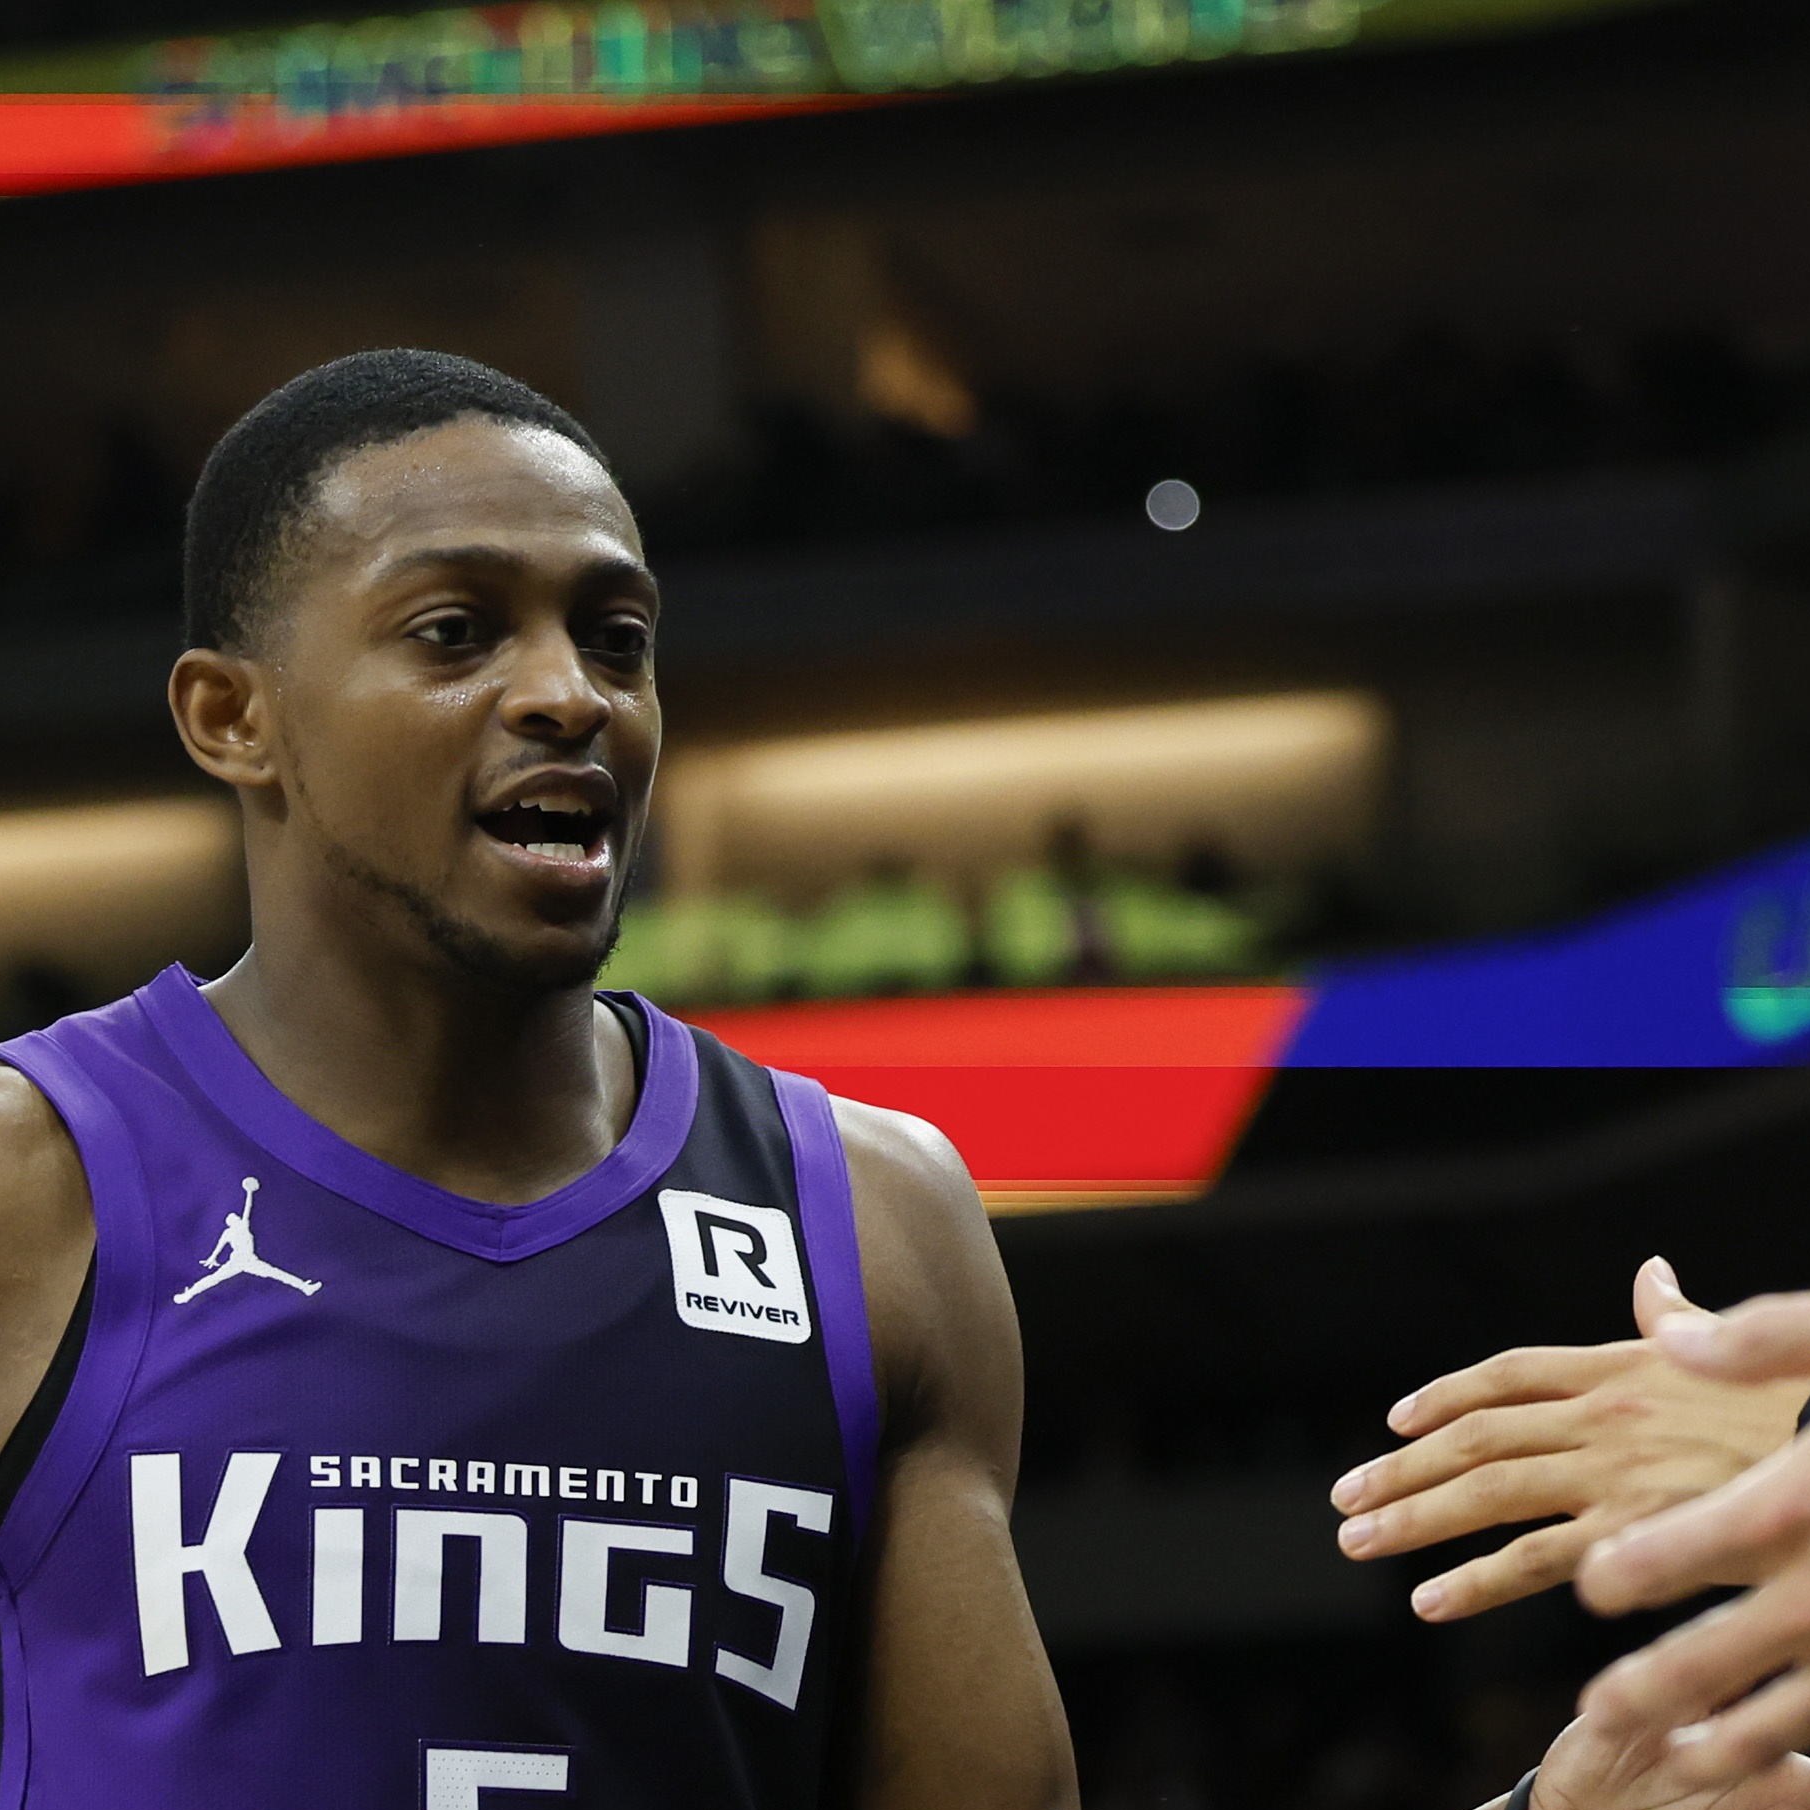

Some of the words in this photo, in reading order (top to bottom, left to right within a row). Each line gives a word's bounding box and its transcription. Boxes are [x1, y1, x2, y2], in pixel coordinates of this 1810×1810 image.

[694, 1210, 777, 1289] R
[686, 1291, 800, 1326] REVIVER
[310, 1455, 699, 1508] SACRAMENTO
[129, 1452, 834, 1711] KINGS
